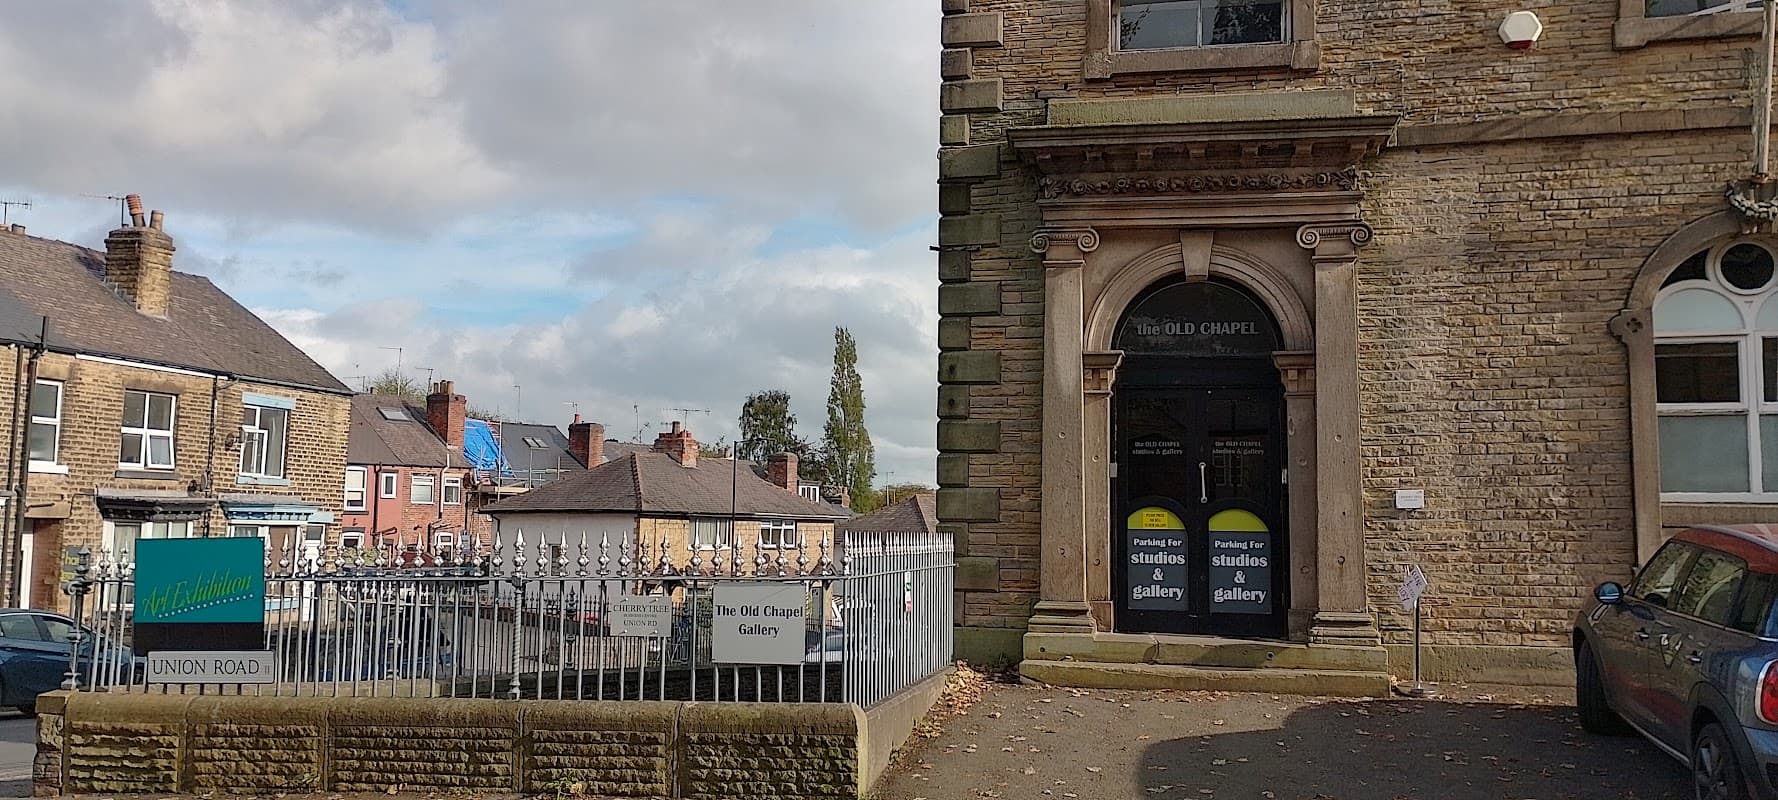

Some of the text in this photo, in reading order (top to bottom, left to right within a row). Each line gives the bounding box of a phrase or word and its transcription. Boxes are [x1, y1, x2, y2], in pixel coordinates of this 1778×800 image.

[1137, 321, 1259, 336] the OLD CHAPEL
[1133, 538, 1182, 548] Parking For
[1215, 540, 1265, 549] Parking For
[1131, 551, 1186, 565] studios
[1212, 553, 1268, 567] studios
[1152, 568, 1164, 581] &
[1234, 570, 1246, 584] &
[142, 568, 252, 616] Art Exhibition
[1132, 585, 1184, 600] gallery
[1214, 587, 1267, 603] gallery
[715, 604, 803, 619] The Old Chapel
[623, 619, 658, 627] UNION RD
[738, 623, 780, 638] Gallery
[152, 659, 206, 675] UNION
[214, 659, 260, 675] ROAD
